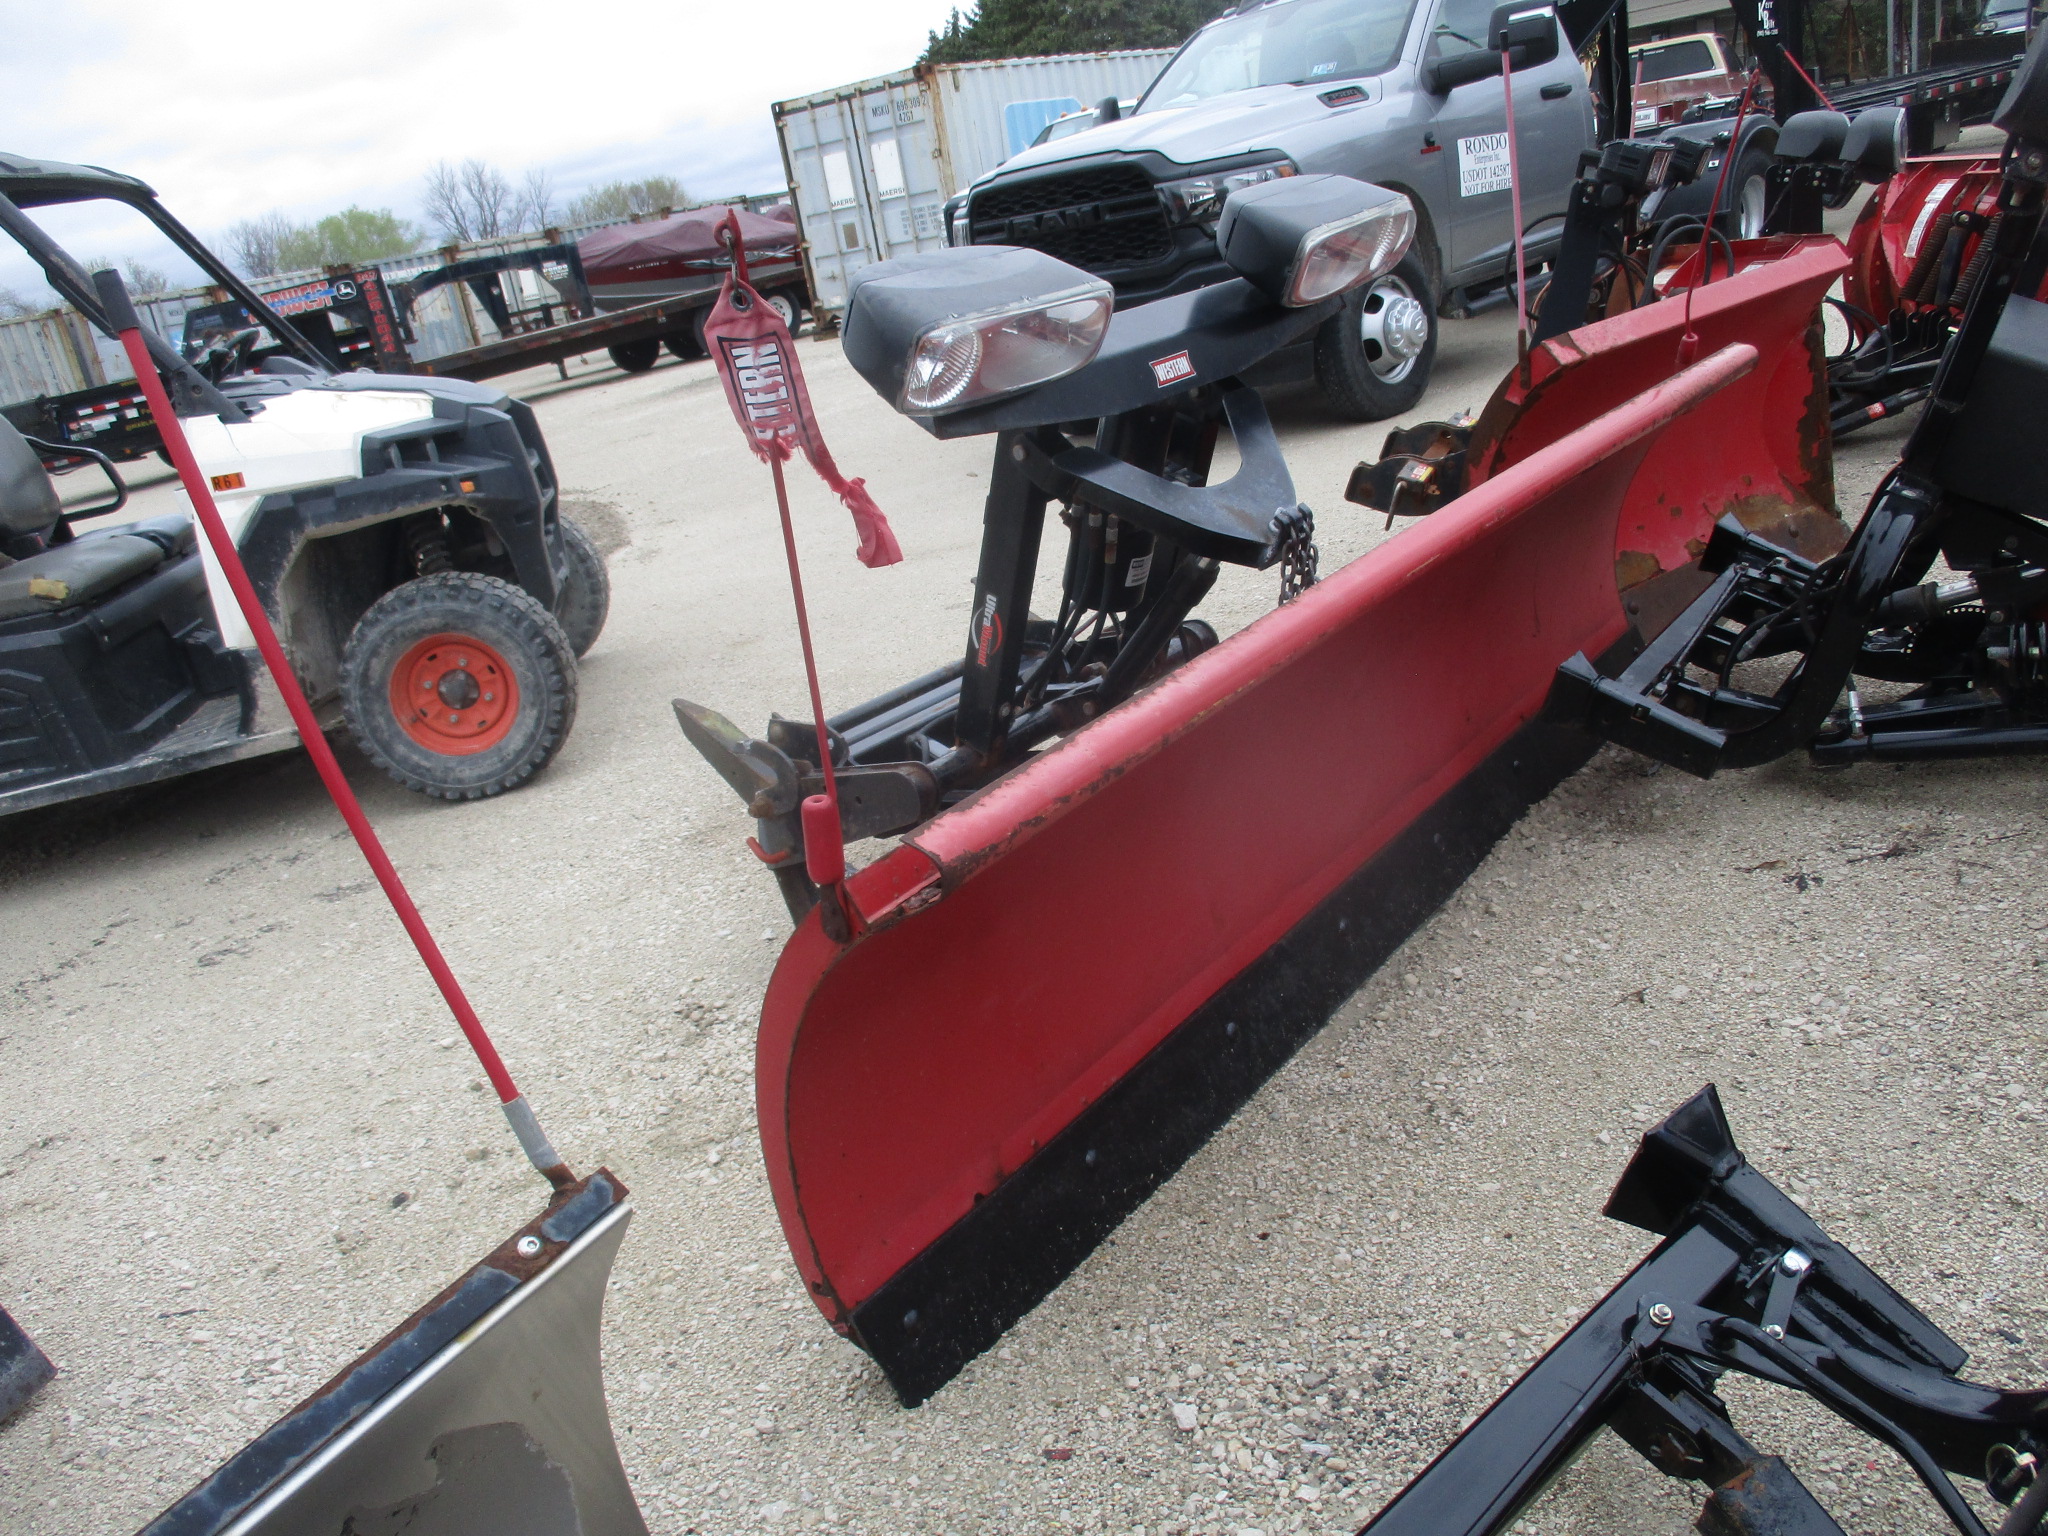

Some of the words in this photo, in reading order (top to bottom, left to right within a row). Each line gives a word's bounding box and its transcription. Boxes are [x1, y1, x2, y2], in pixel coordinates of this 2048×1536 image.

[872, 105, 890, 117] MSKU
[1465, 134, 1507, 155] RONDO
[1462, 167, 1487, 183] USDOT
[1489, 164, 1512, 179] 142587
[1465, 183, 1480, 195] NOT
[1480, 181, 1494, 192] FOR
[1495, 178, 1512, 190] HIRE
[1154, 356, 1191, 382] WESTERN
